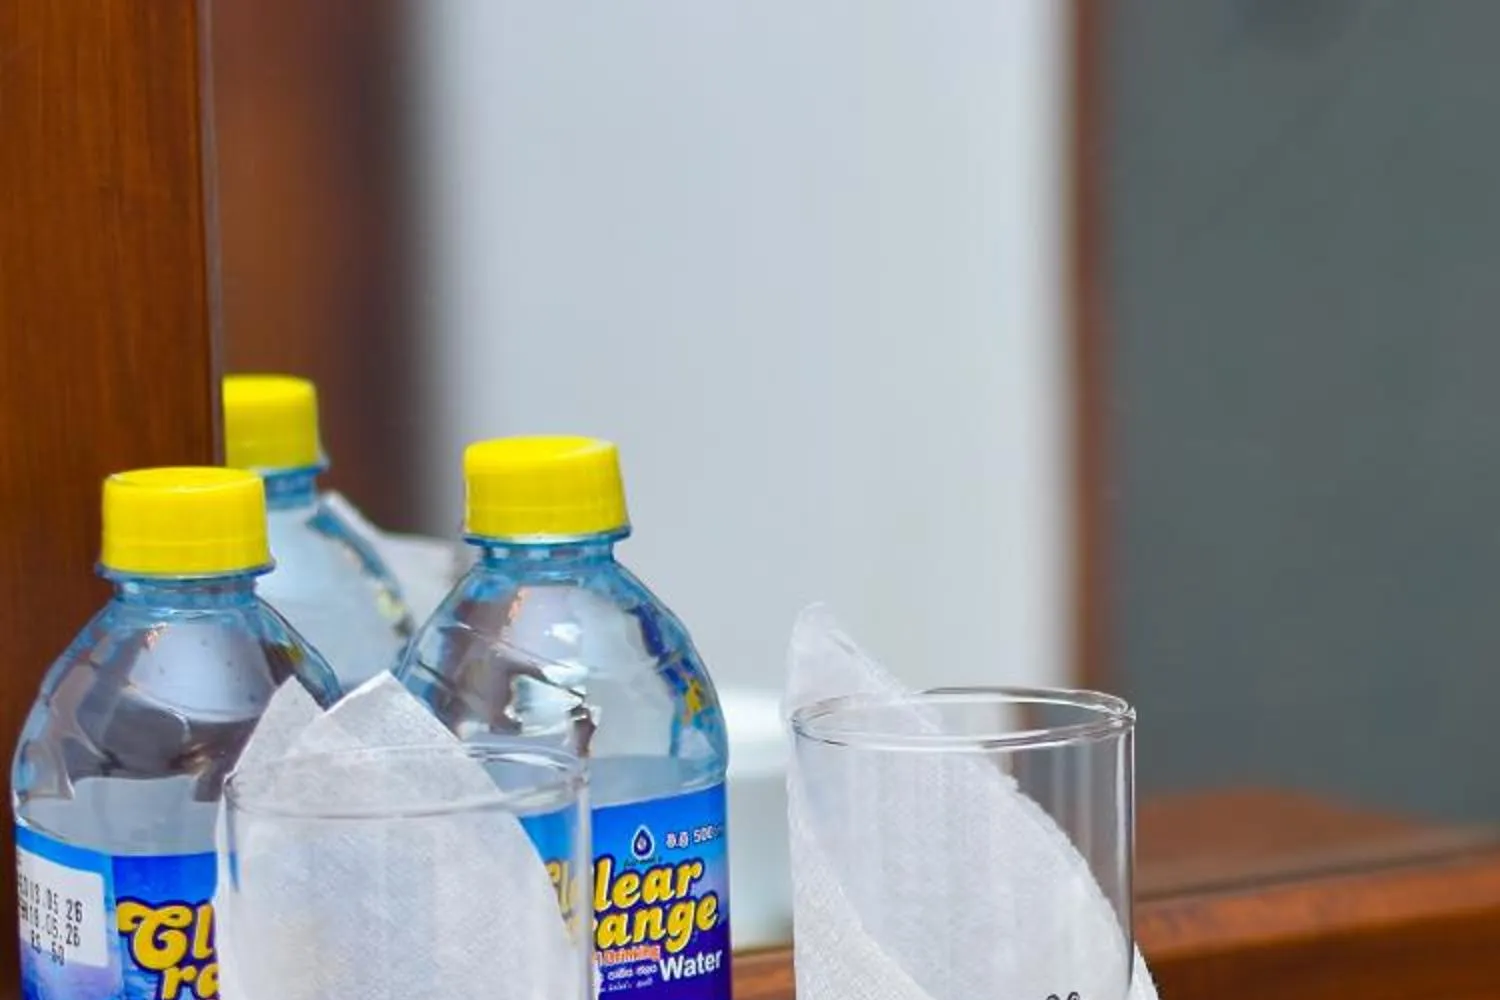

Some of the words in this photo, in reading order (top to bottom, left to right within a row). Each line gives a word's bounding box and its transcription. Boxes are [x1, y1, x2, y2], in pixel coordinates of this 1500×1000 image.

[591, 857, 703, 912] lear
[591, 895, 718, 953] ange
[660, 950, 723, 981] Water
